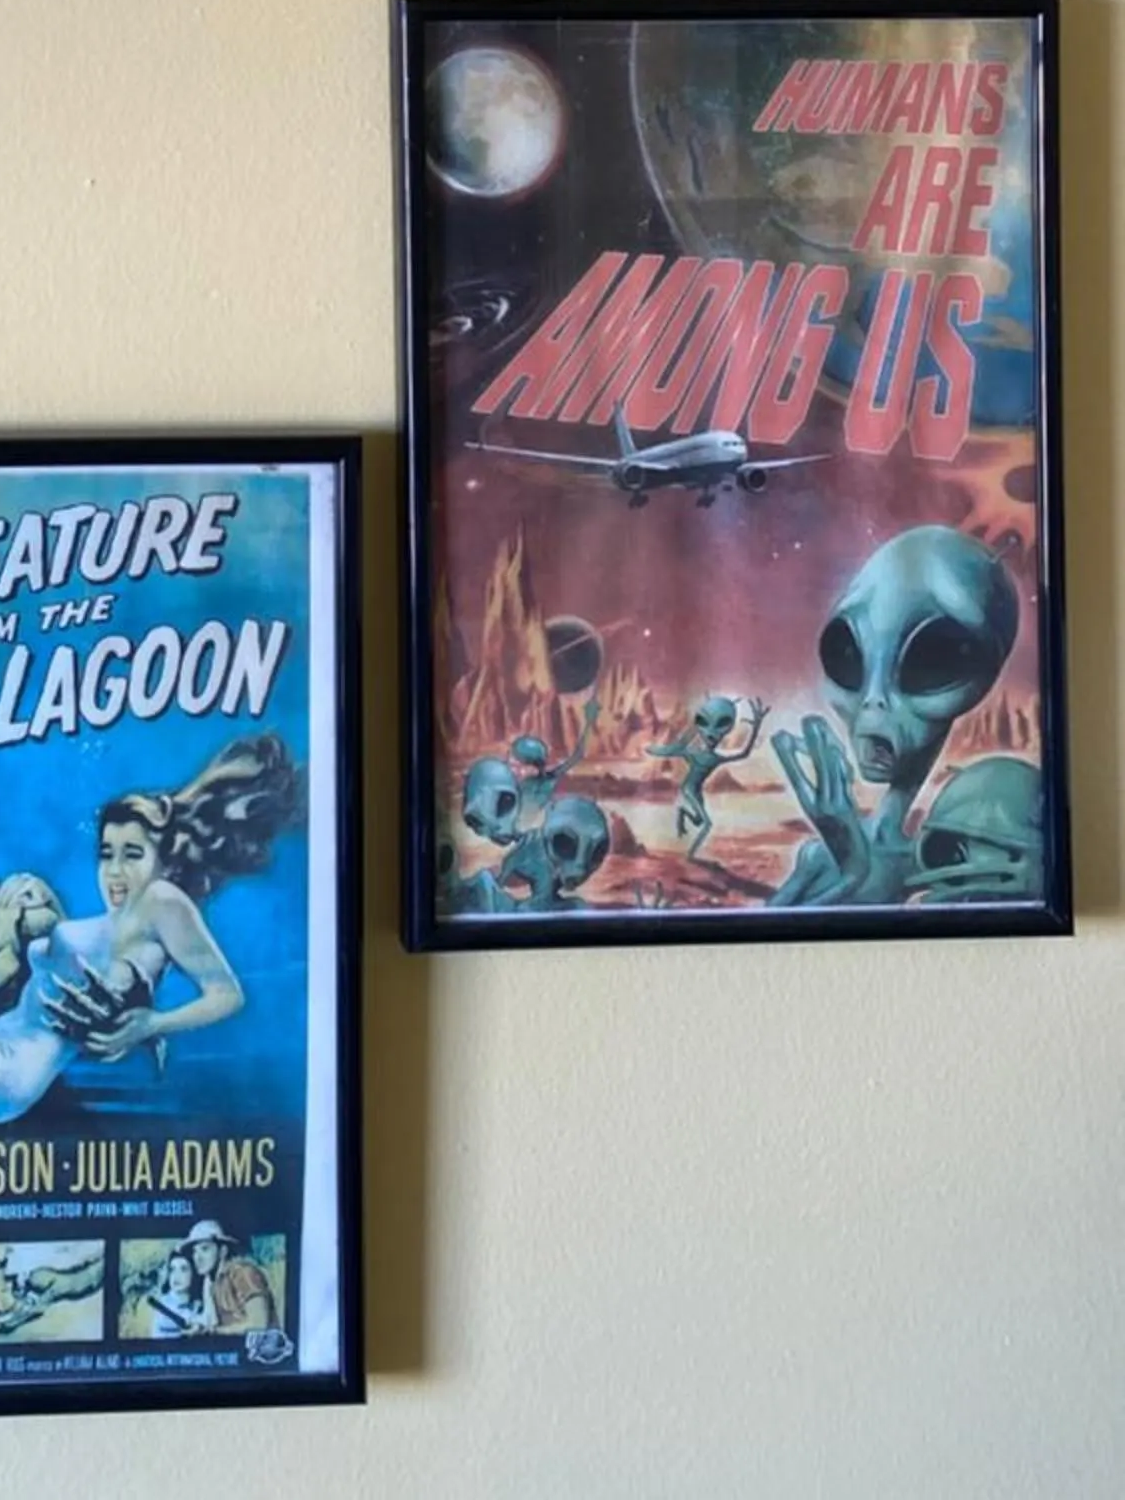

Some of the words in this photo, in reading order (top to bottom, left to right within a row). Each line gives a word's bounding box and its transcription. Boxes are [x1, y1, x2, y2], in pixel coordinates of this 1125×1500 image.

[752, 58, 1008, 136] HUMANS
[850, 145, 1000, 258] ARE
[471, 251, 850, 445] AMONG
[843, 268, 985, 462] US
[40, 593, 116, 630] THE
[70, 1140, 153, 1192] JULIA
[159, 1137, 276, 1190] ADAMS
